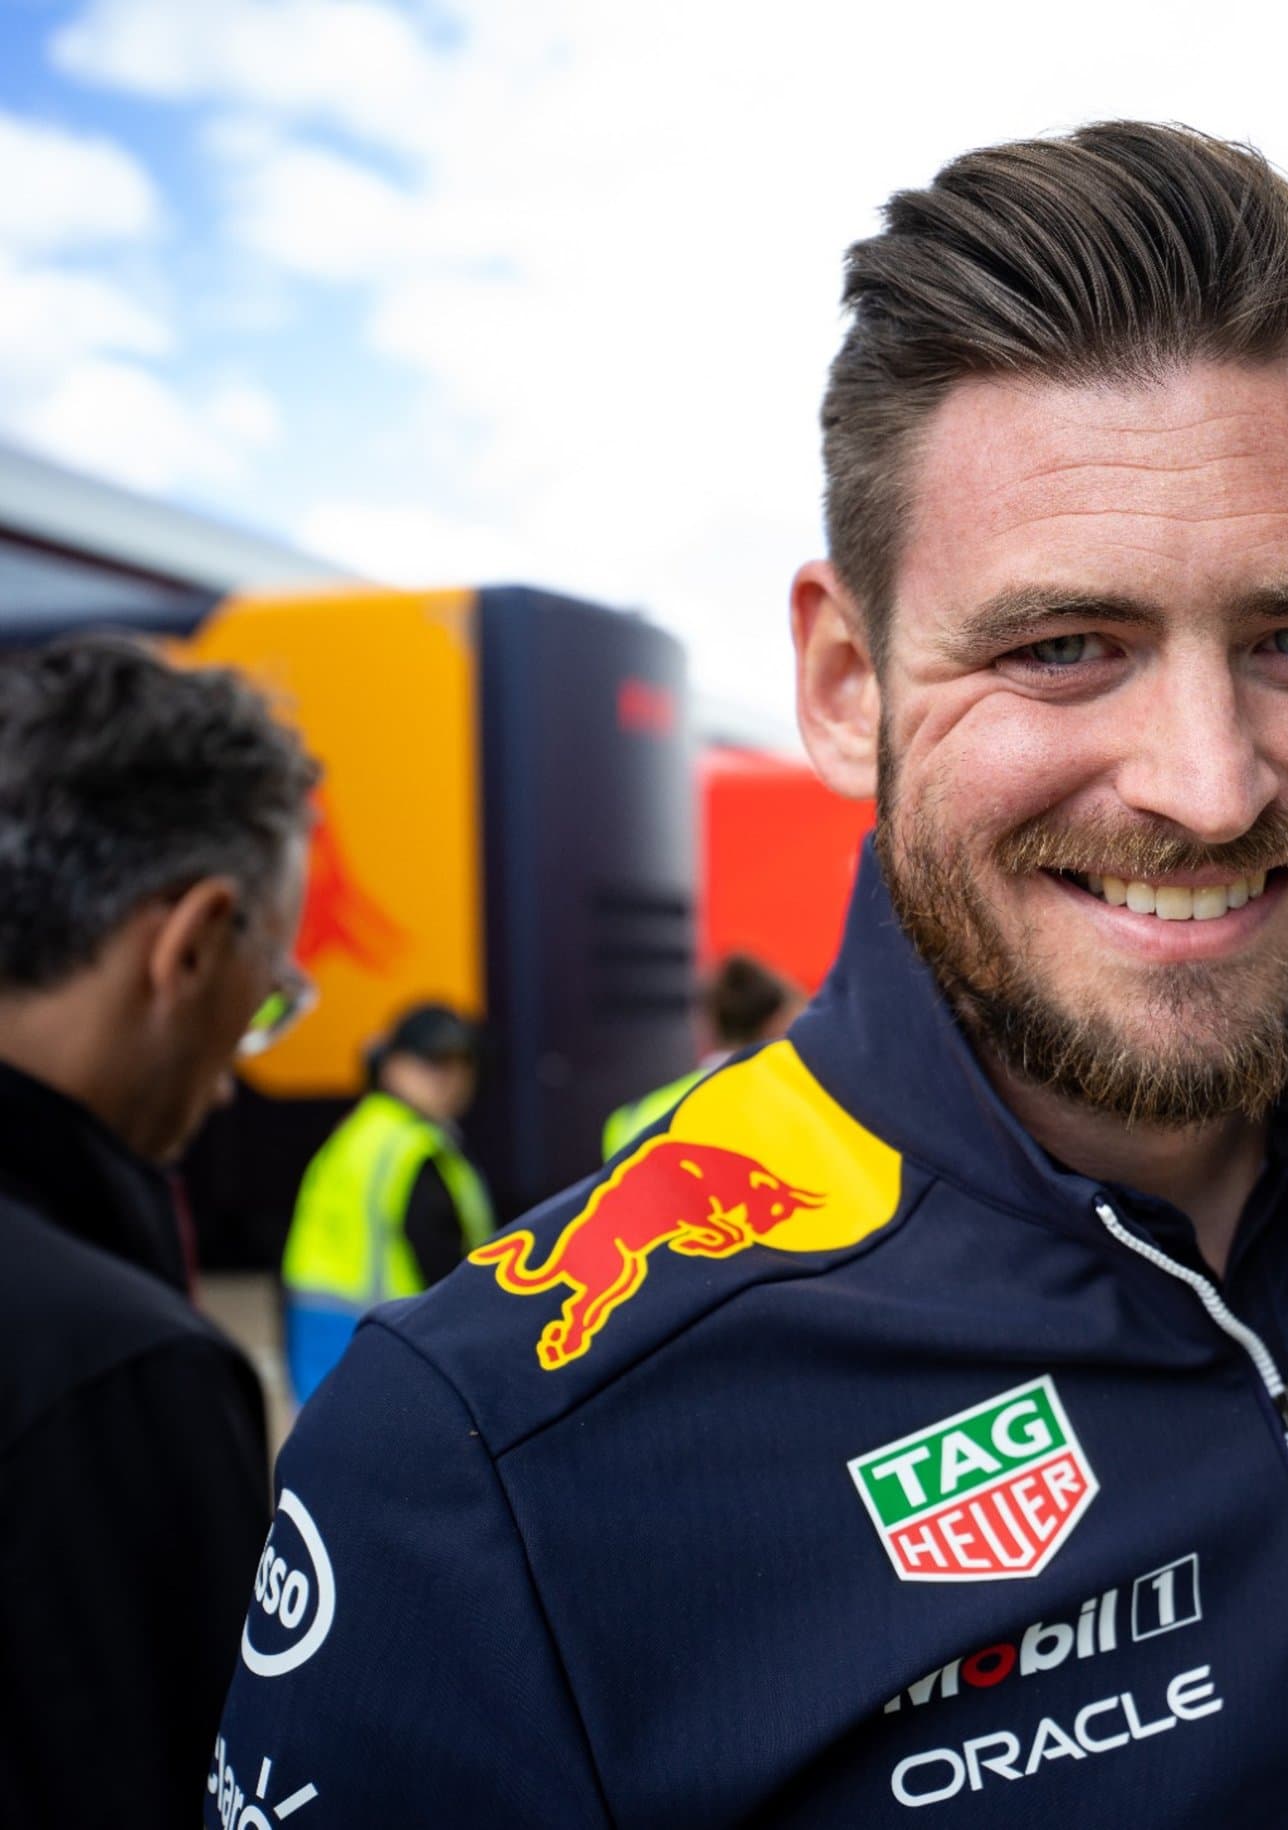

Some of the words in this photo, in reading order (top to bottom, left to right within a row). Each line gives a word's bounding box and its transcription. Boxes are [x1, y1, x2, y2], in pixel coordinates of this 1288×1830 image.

[872, 1399, 1053, 1508] TAG
[898, 1460, 1082, 1569] HEUER
[254, 1545, 309, 1629] sso
[1152, 1571, 1175, 1626] 1
[890, 1664, 1224, 1808] ORACLE
